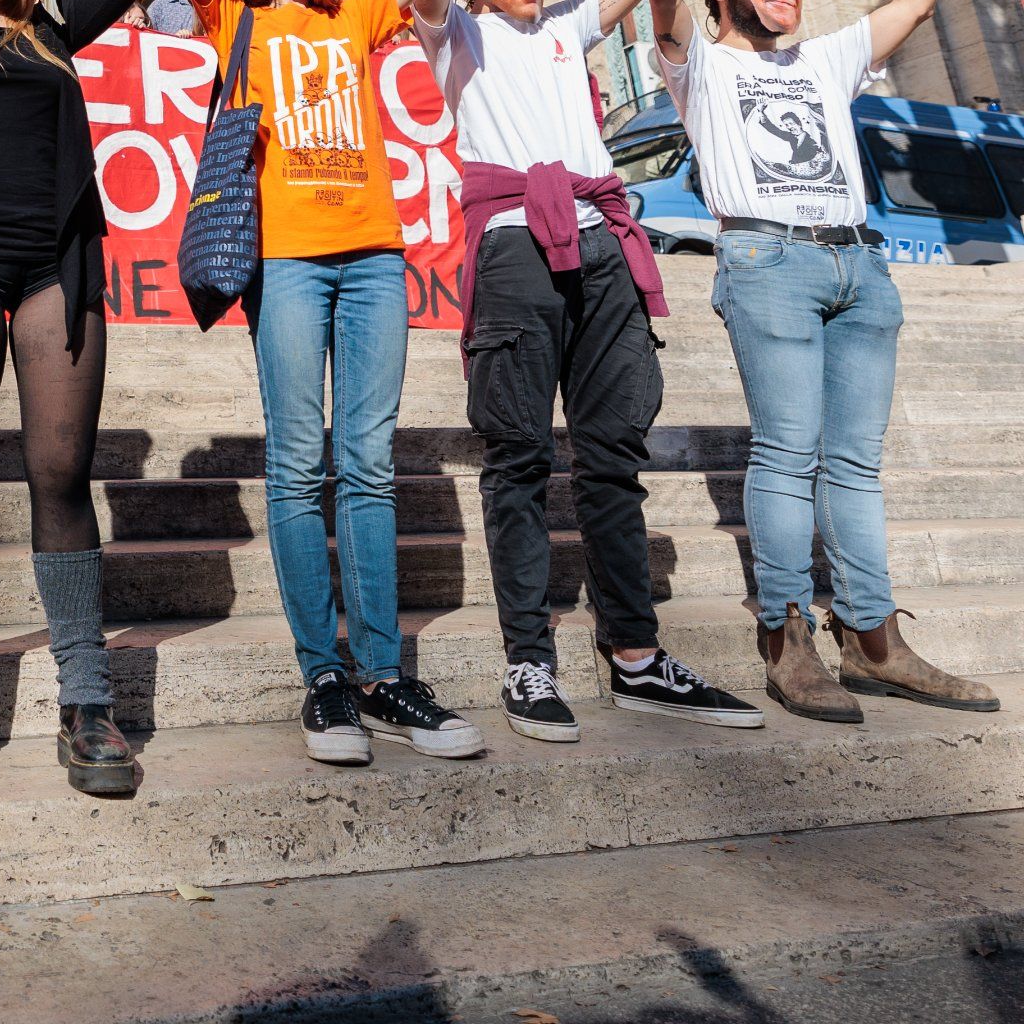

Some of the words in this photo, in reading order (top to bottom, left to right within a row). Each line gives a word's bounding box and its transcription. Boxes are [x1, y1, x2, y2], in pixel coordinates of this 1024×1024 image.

[757, 185, 769, 195] IN
[773, 184, 850, 196] ESPANSIONE
[883, 236, 957, 265] IZIA
